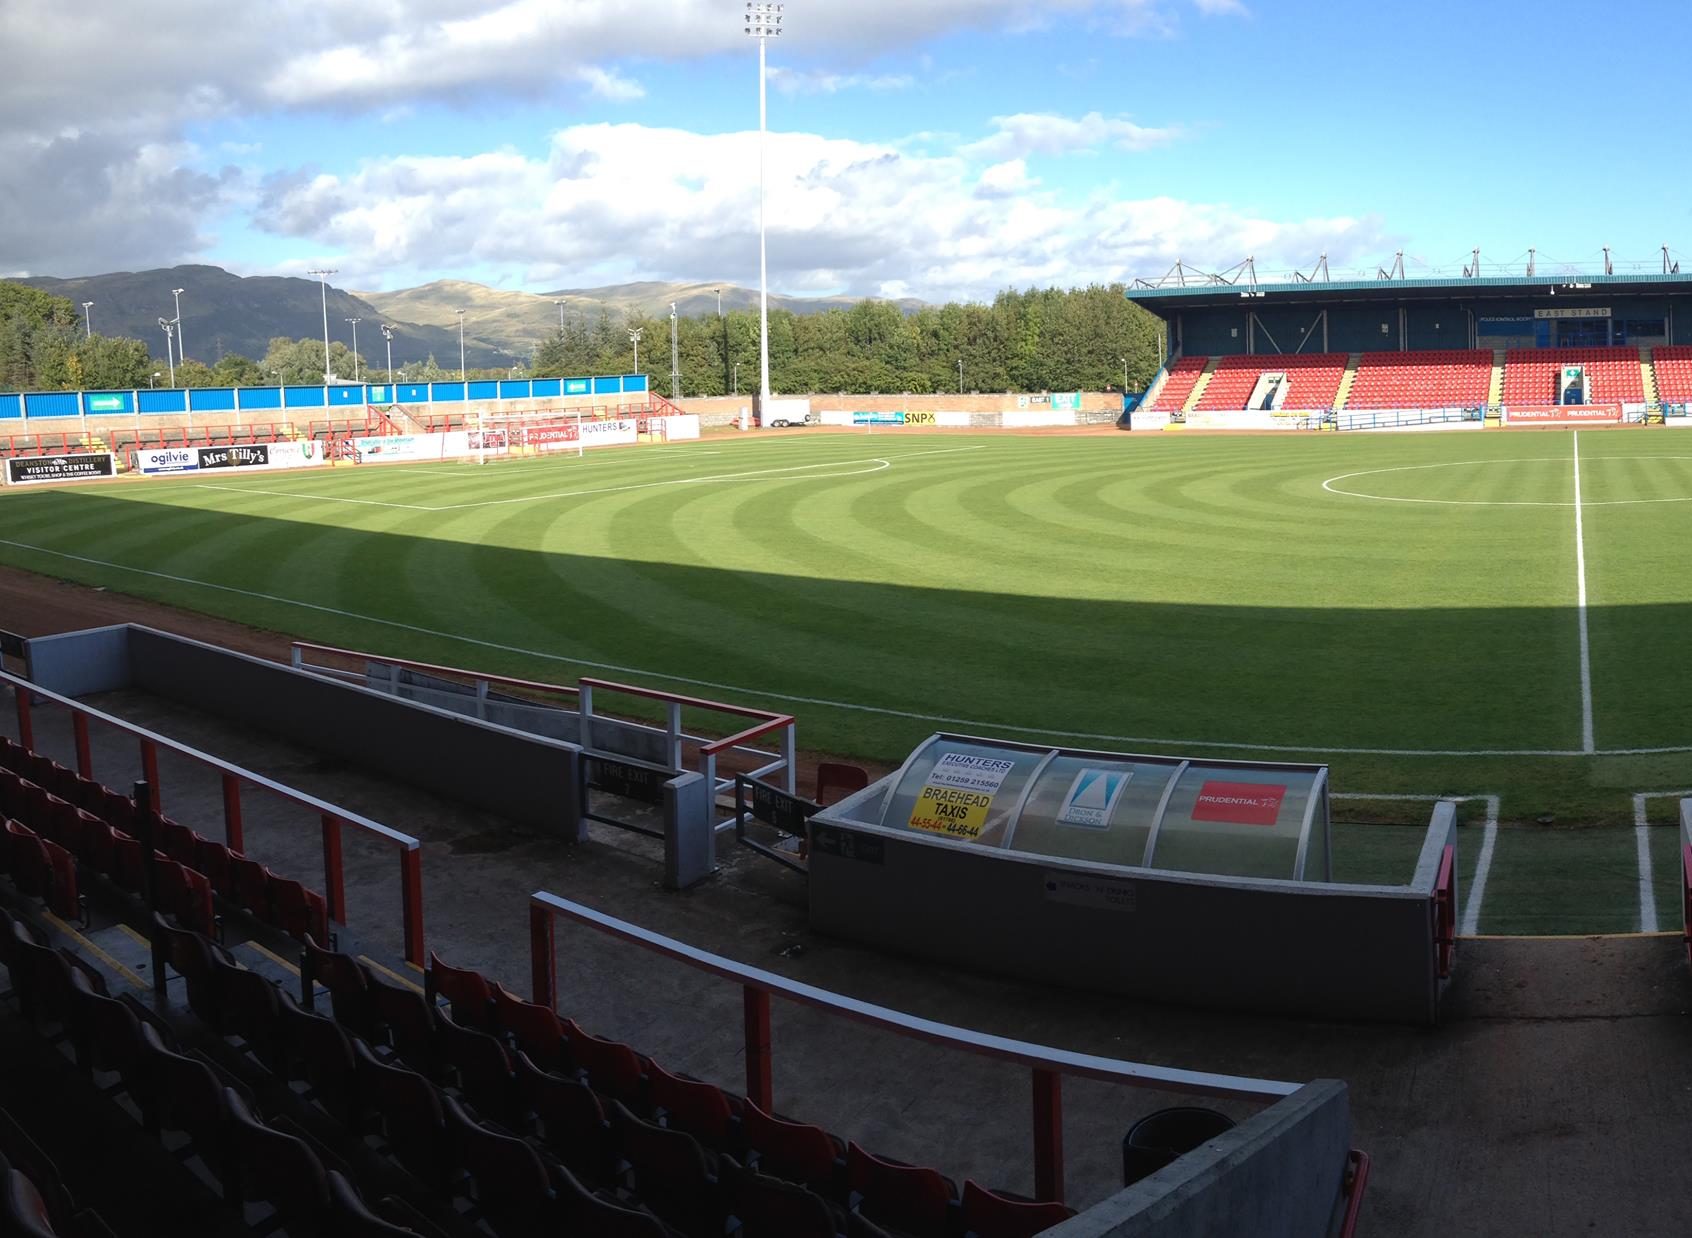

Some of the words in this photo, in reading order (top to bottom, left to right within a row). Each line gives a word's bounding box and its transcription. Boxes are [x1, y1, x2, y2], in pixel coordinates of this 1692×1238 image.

[905, 413, 928, 423] SNP
[582, 422, 617, 433] HUNTERS
[151, 451, 189, 465] ogilvie
[203, 452, 228, 466] Mrs
[229, 448, 265, 464] Tilly's
[27, 465, 61, 474] VISITOR
[63, 463, 96, 472] CENTRE
[945, 754, 1011, 769] HUNTERS
[603, 762, 625, 778] FIRE
[627, 767, 649, 784] EXIT
[946, 775, 970, 784] 01259
[970, 778, 999, 788] 215560
[923, 788, 990, 808] BRAEHEAD
[1200, 796, 1258, 806] PRUDENTIAL
[775, 795, 792, 816] EXIT
[934, 802, 968, 819] TAXIS
[1069, 807, 1094, 817] DRON
[1065, 814, 1102, 826] DICKSON
